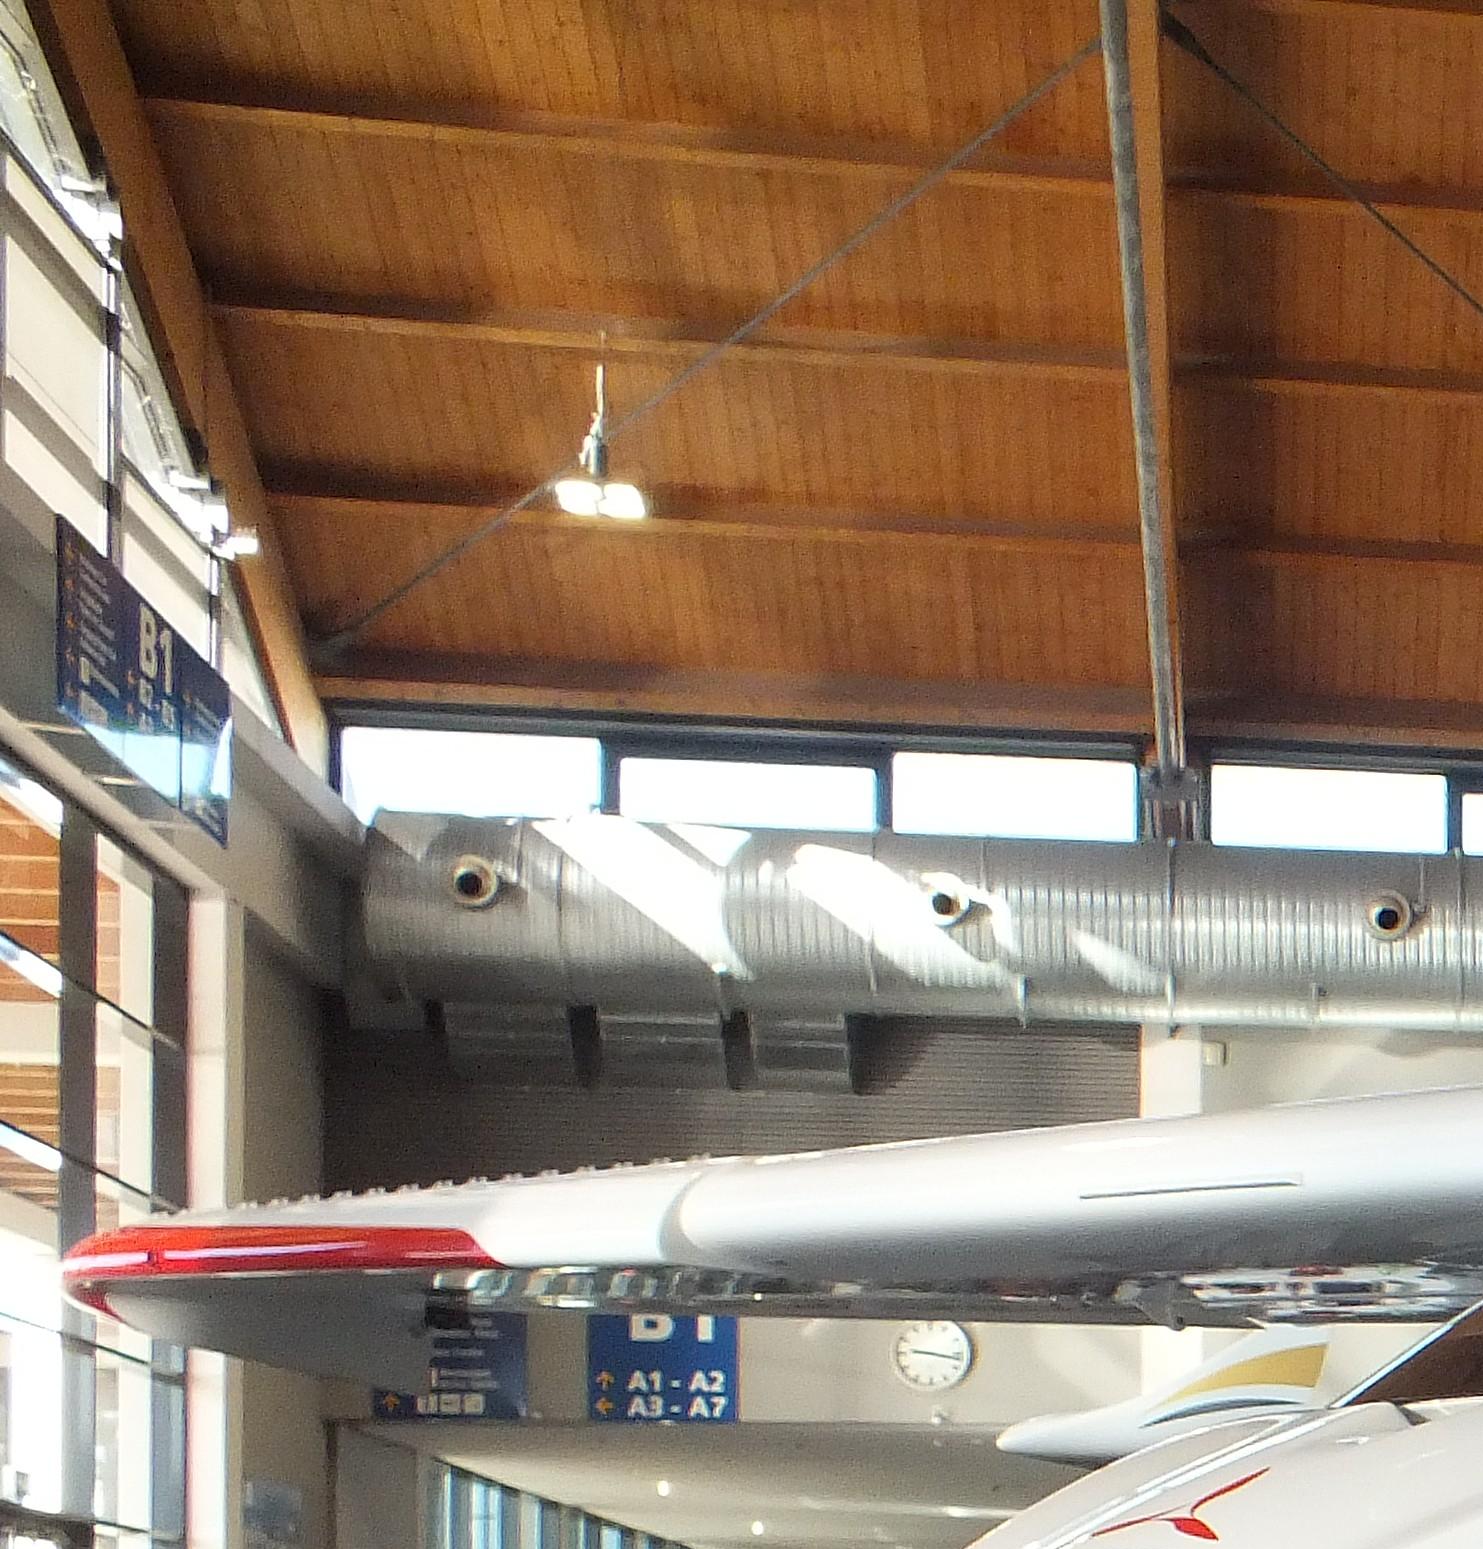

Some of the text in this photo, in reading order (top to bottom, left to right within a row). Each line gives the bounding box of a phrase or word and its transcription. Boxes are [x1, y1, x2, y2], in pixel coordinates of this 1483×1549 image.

[139, 602, 174, 697] B1
[627, 1369, 664, 1393] A1
[689, 1369, 726, 1394] A2
[627, 1394, 664, 1418] A3
[688, 1394, 729, 1419] A7
